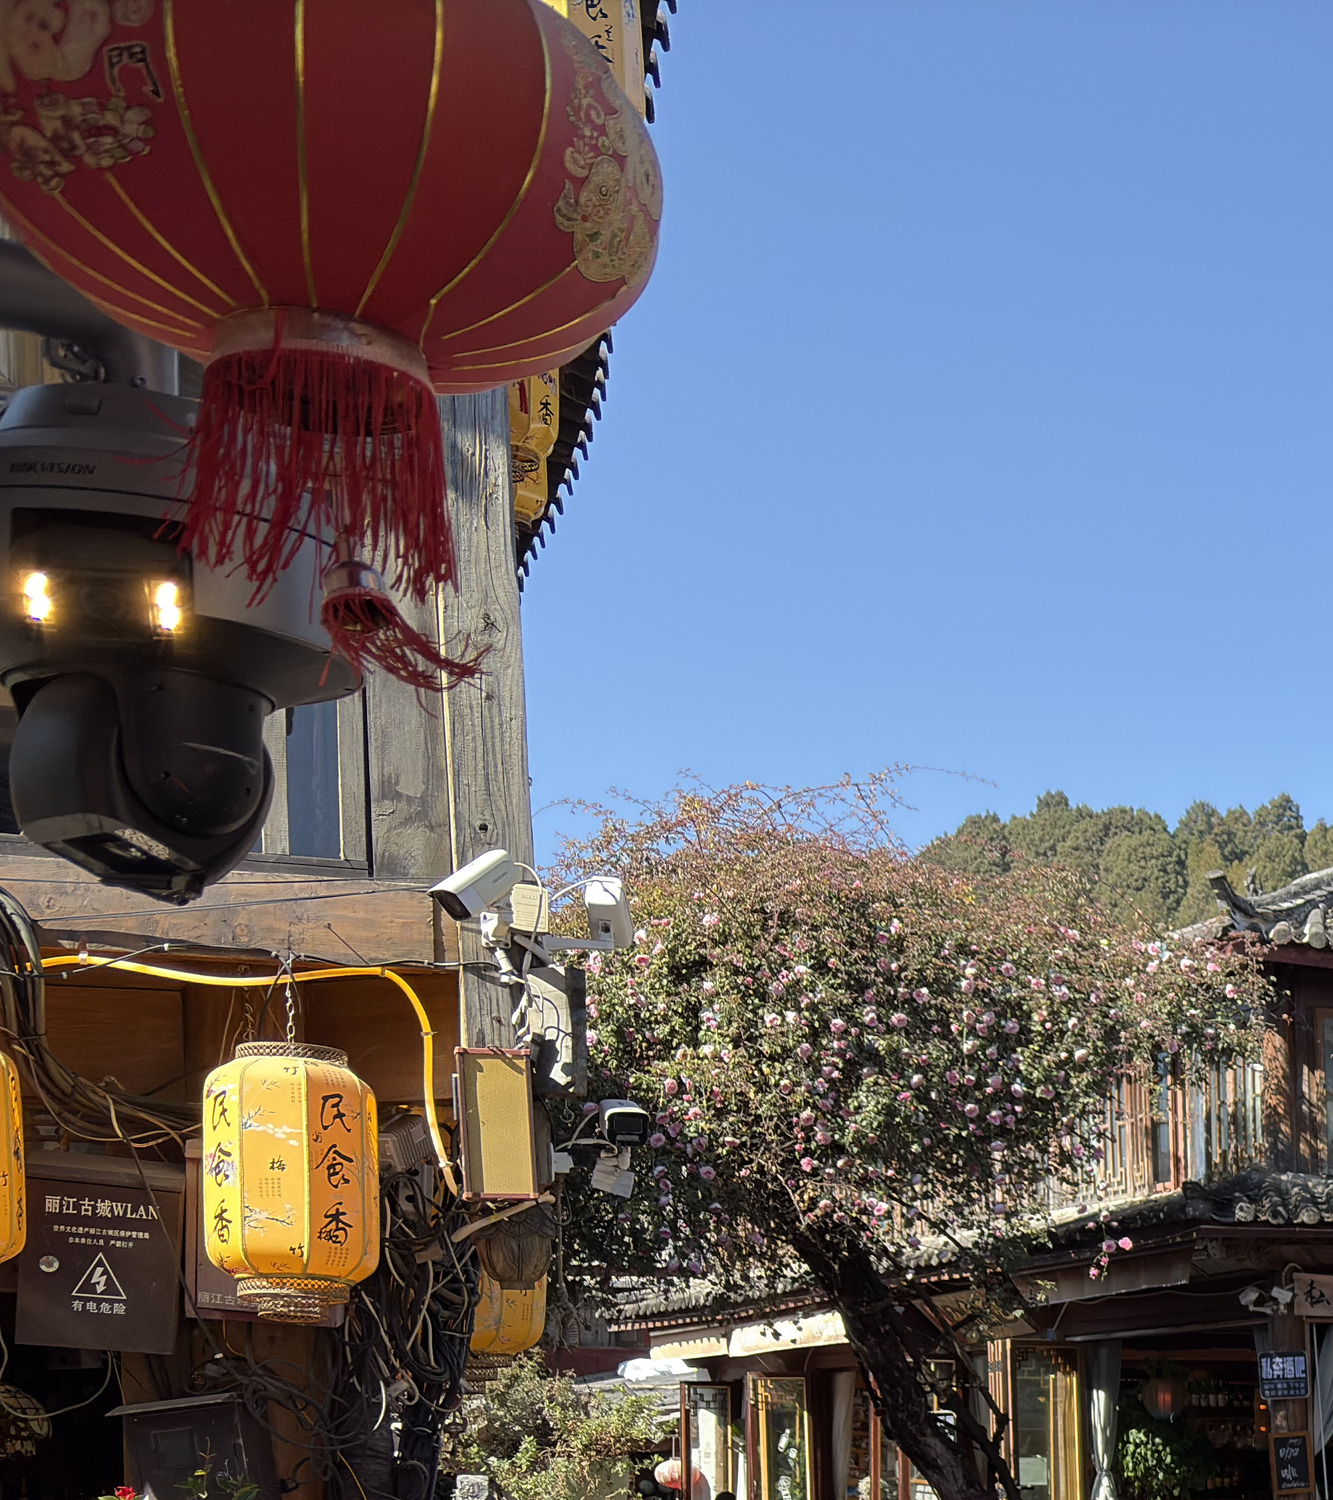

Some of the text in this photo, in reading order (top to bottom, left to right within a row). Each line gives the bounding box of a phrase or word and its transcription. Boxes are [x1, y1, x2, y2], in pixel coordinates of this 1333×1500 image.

[269, 1155, 287, 1172] 梅
[44, 1195, 160, 1220] 丽江古城WLAN
[71, 1300, 127, 1315] 有电危险
[1261, 1356, 1306, 1379] 私奔酒吧
